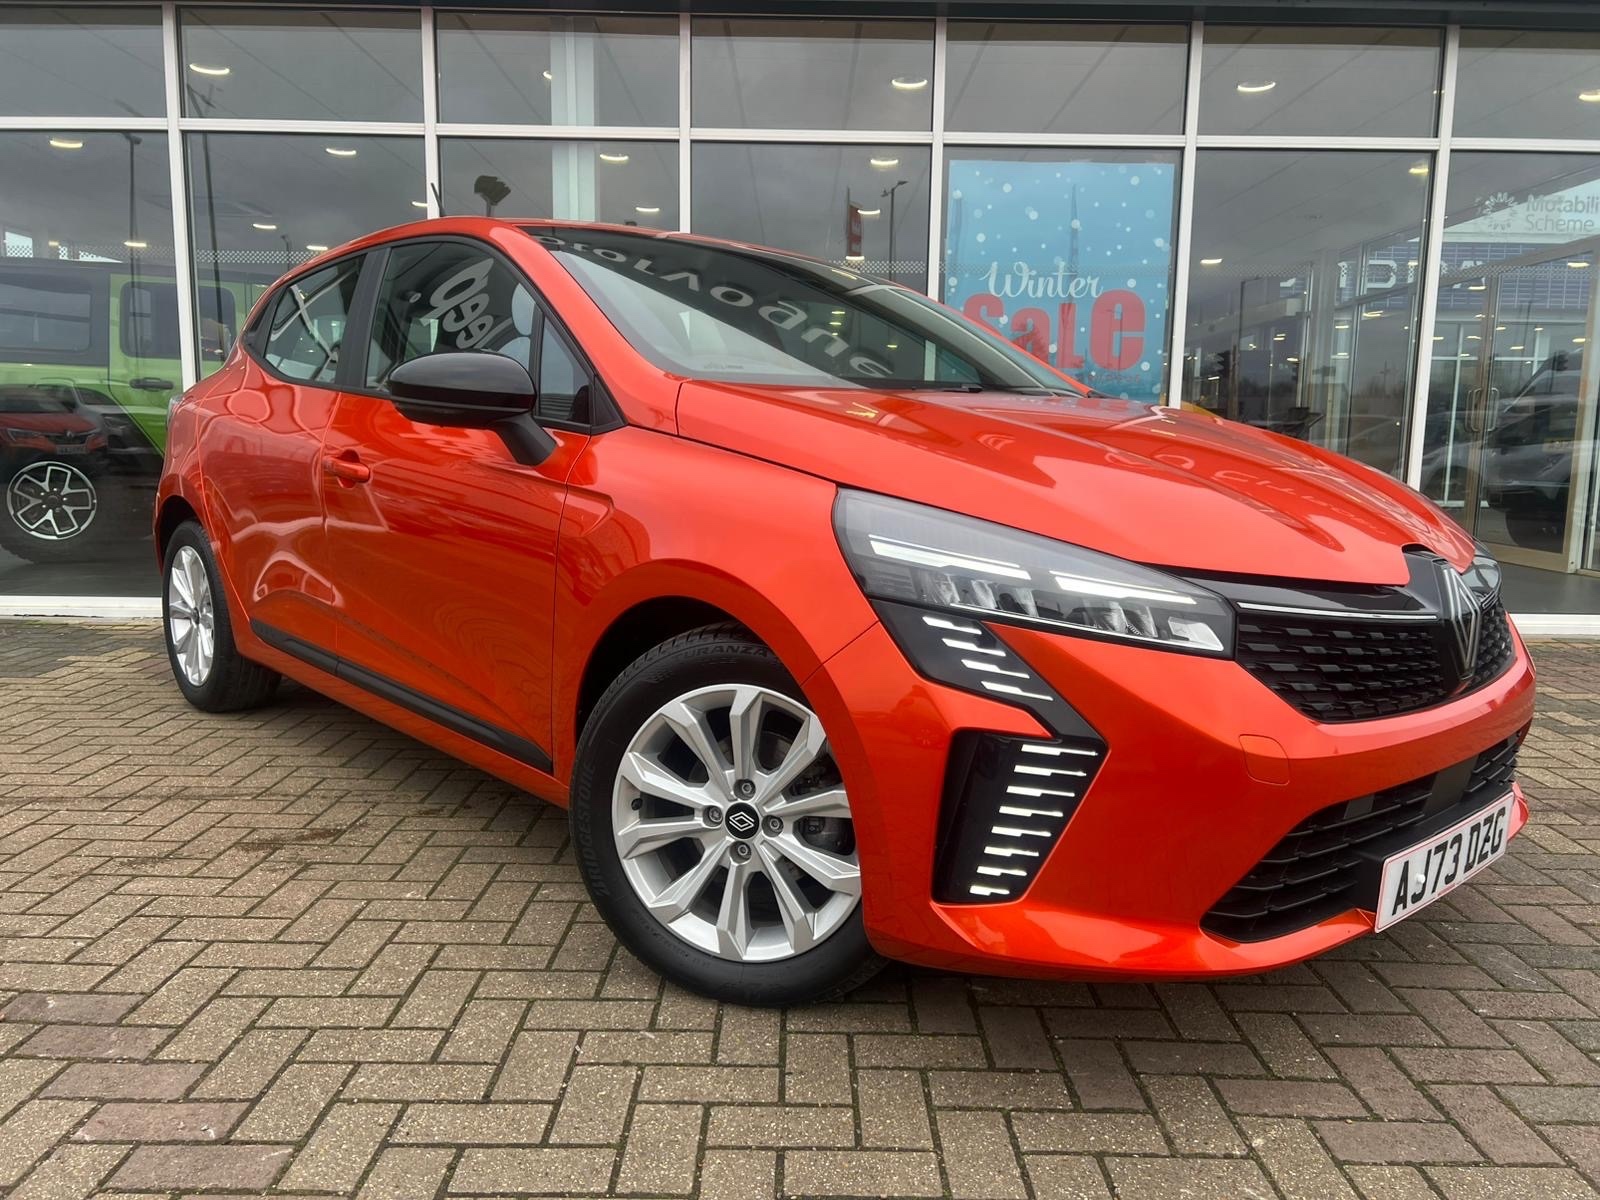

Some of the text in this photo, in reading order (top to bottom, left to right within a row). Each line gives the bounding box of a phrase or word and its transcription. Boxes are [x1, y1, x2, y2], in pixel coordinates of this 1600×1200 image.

[1525, 214, 1594, 232] Scheme
[979, 261, 1105, 298] Winter
[1392, 806, 1507, 916] AJ73 DZG
